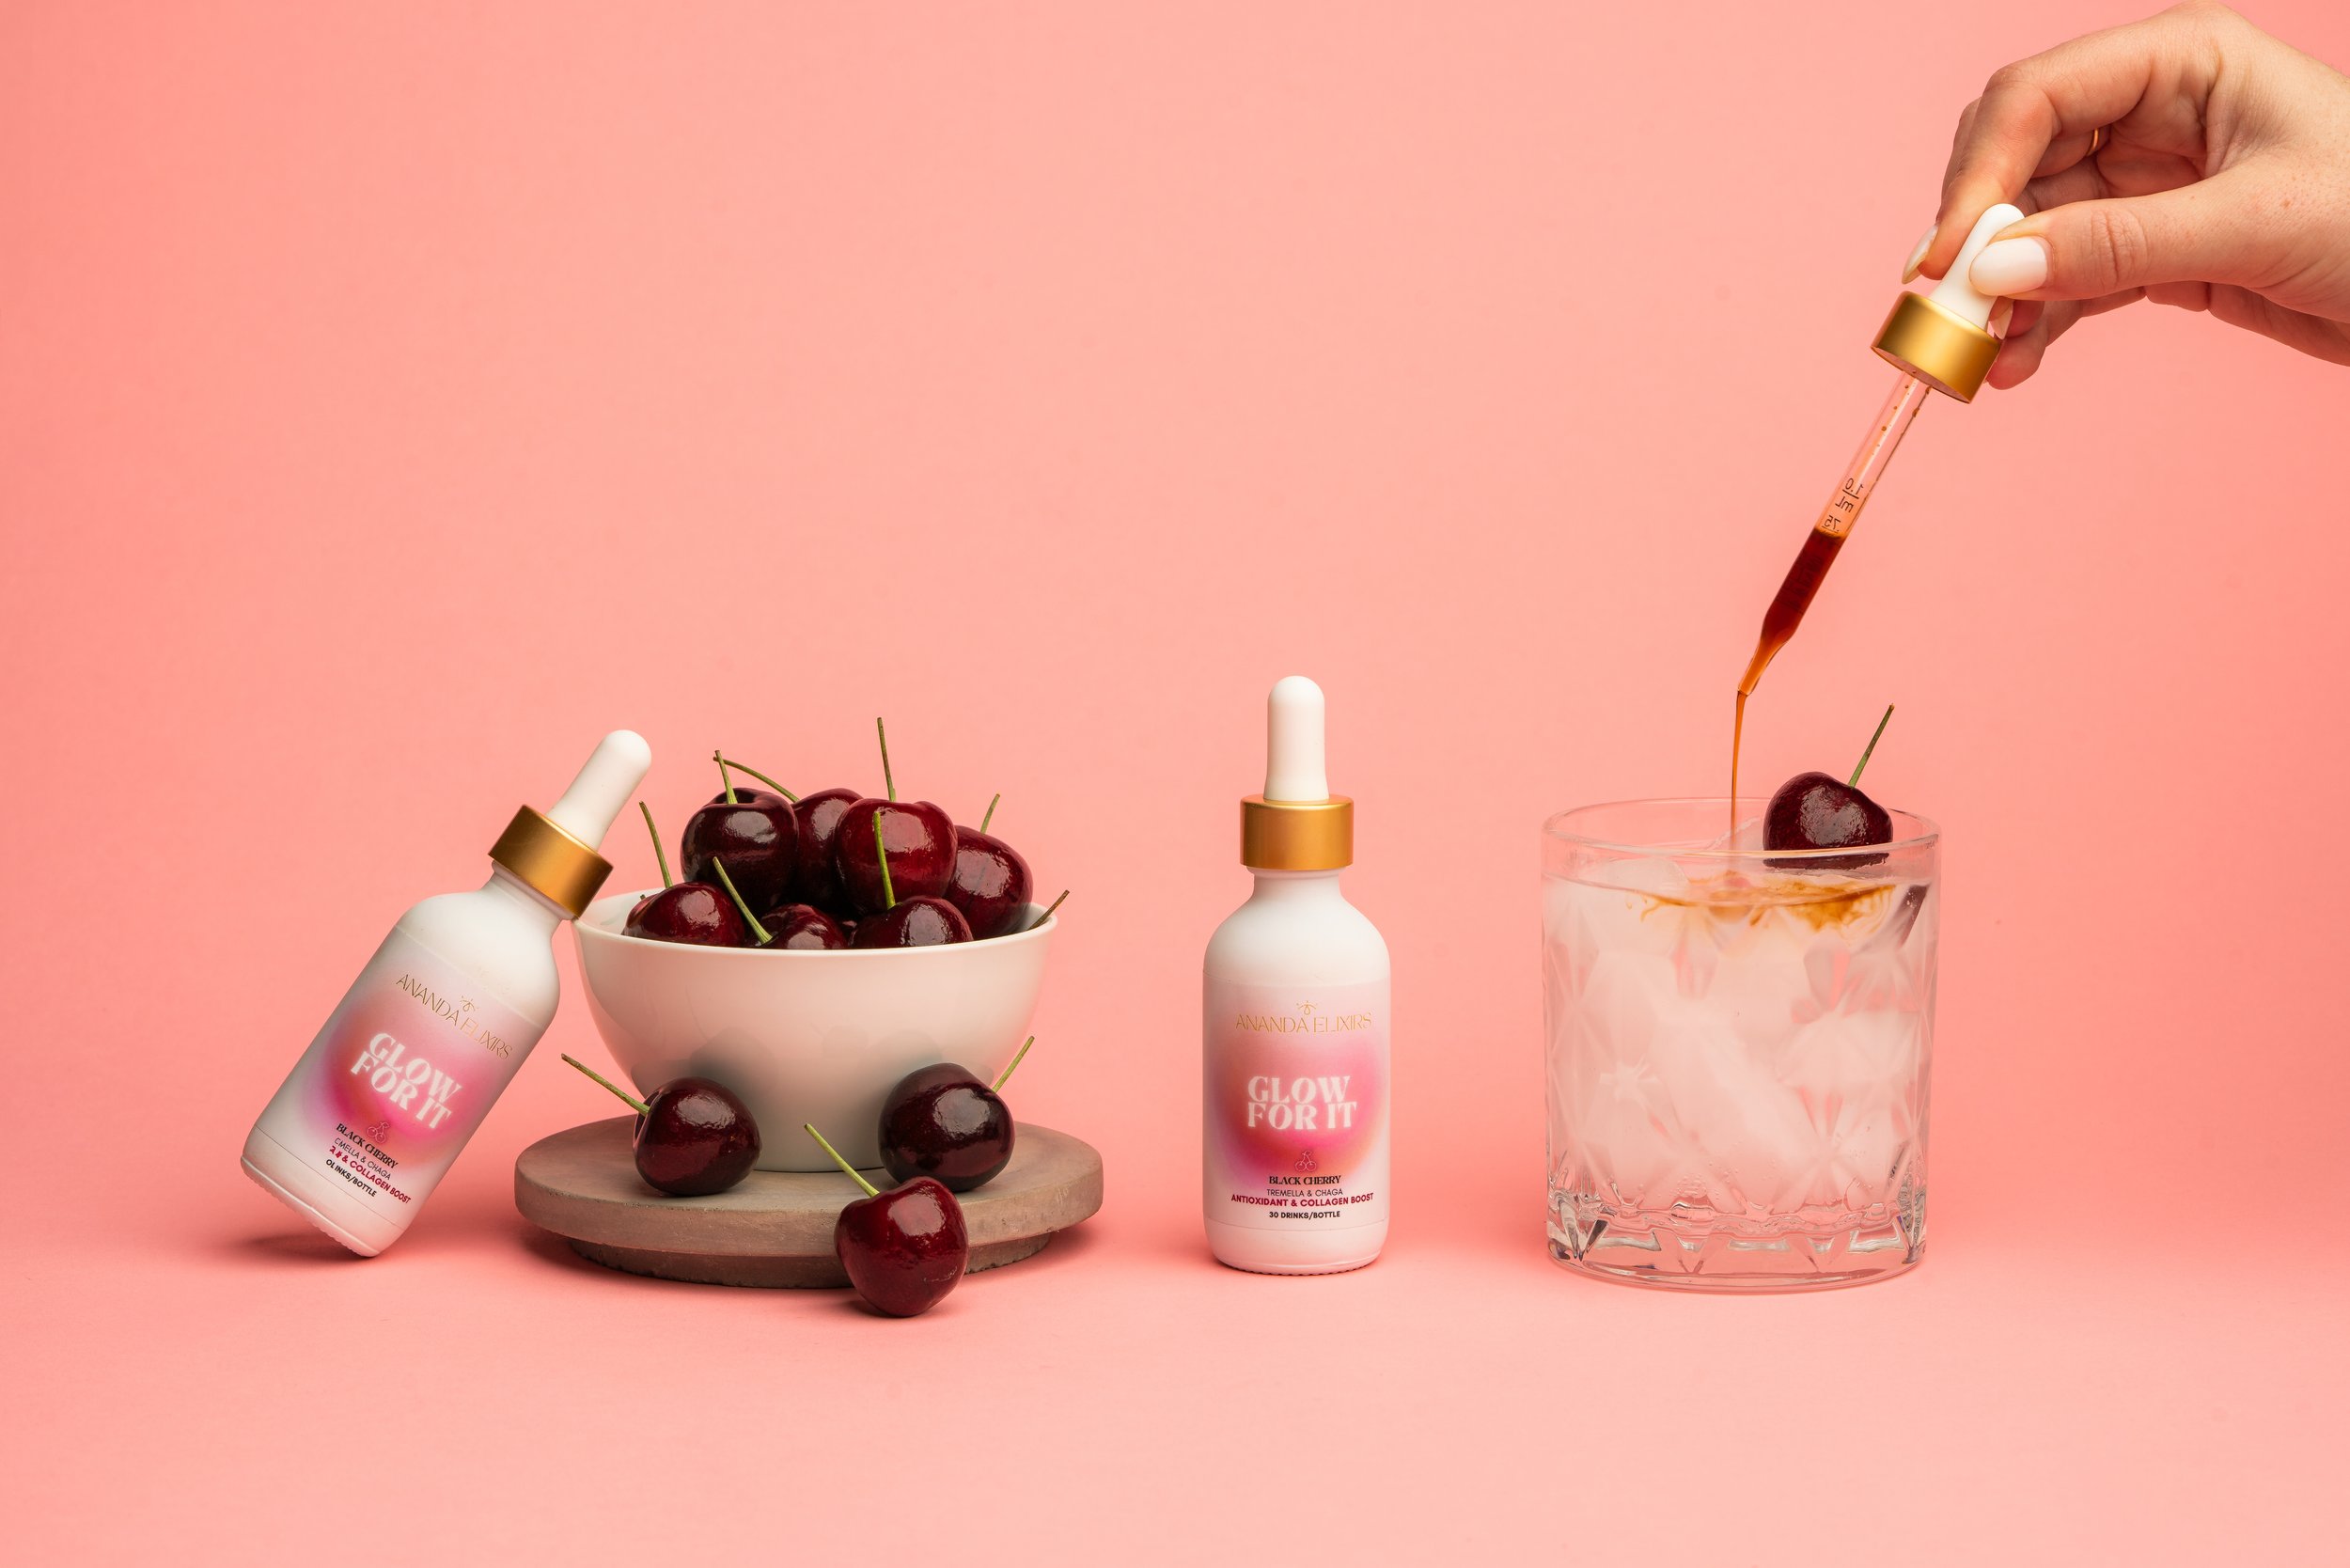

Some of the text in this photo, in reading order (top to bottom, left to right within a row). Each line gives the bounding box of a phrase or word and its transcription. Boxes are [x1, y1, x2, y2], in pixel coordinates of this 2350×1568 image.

[396, 974, 460, 1027] ANANDA
[1235, 1011, 1372, 1034] ANANDA ELIXIRS
[369, 1032, 462, 1104] GLOW
[350, 1051, 452, 1129] FOR IT
[1247, 1075, 1351, 1104] GLOW
[1247, 1101, 1357, 1131] FOR IT
[336, 1123, 366, 1147] BLACK
[365, 1143, 399, 1168] CHERRY
[350, 1160, 391, 1191] COLLAGEN
[389, 1187, 411, 1204] BOOST
[367, 1160, 391, 1180] CHAGA
[1268, 1174, 1341, 1185] BLACK CHERRY
[1230, 1192, 1373, 1207] ANTIOXIDANT & COLLAGEN BOOST
[1266, 1188, 1305, 1198] TREMELLA
[1315, 1188, 1343, 1197] CHAGA
[1280, 1210, 1340, 1220] DRINKS/BOTTLE
